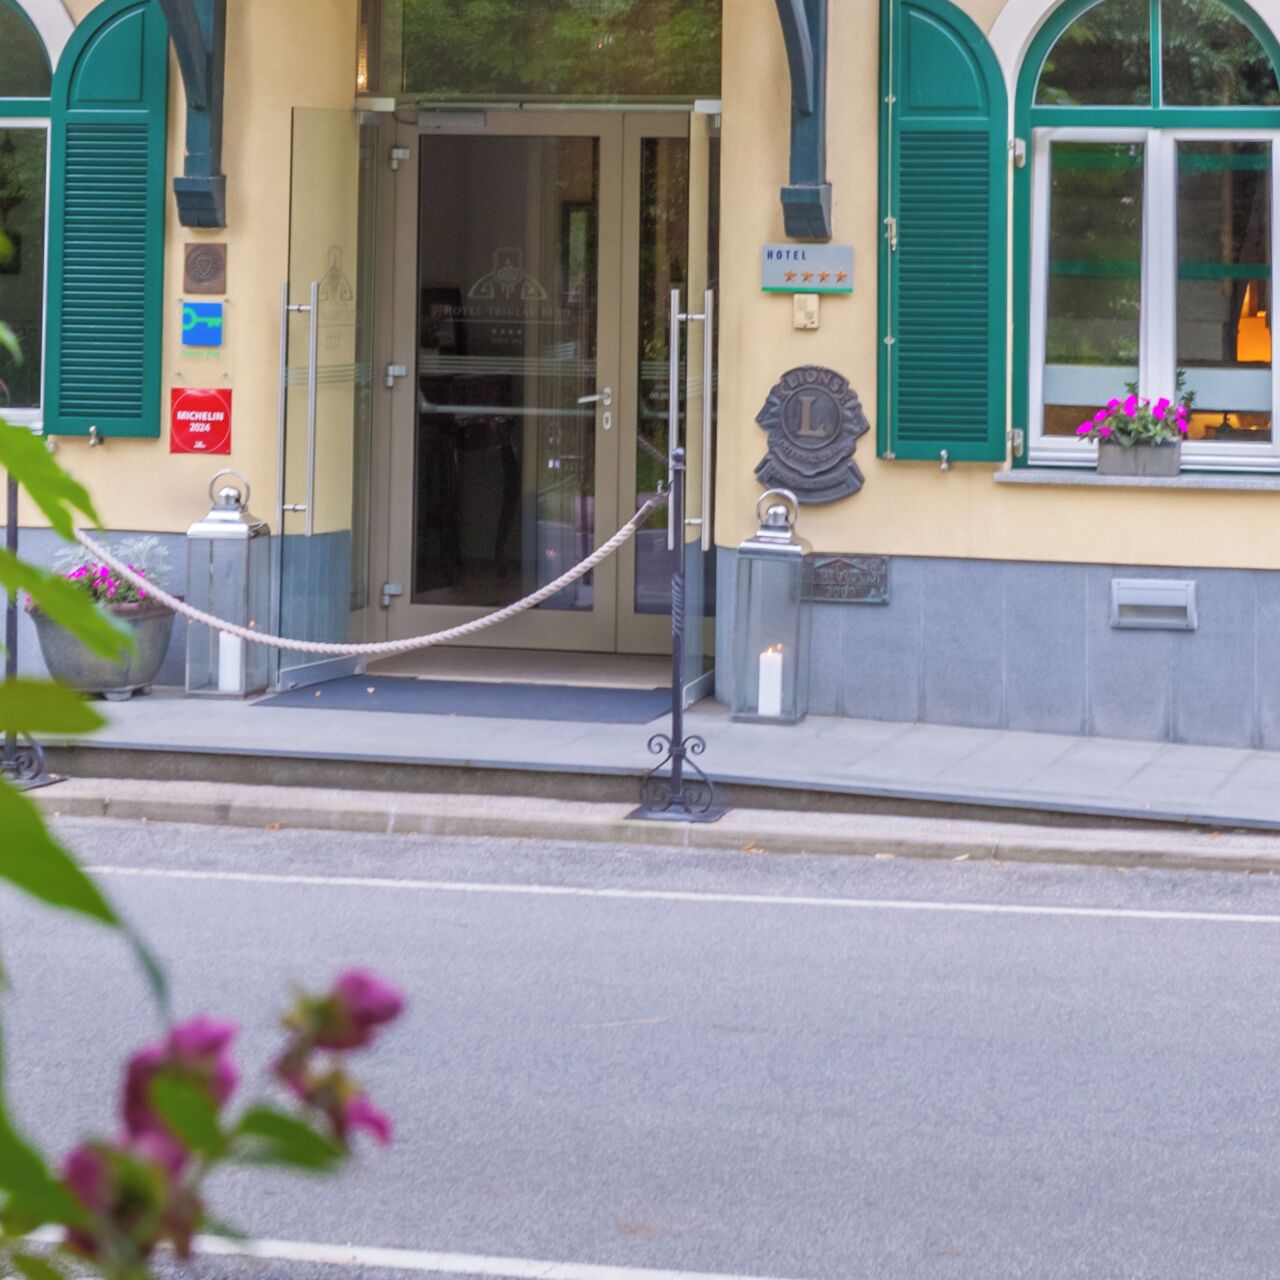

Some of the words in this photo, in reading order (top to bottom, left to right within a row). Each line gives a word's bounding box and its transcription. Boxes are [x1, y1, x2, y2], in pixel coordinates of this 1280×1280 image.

[766, 250, 807, 261] HOTEL
[785, 370, 842, 392] LIONS
[176, 411, 225, 422] MICHELIN
[796, 395, 826, 438] L
[189, 422, 211, 432] 2024
